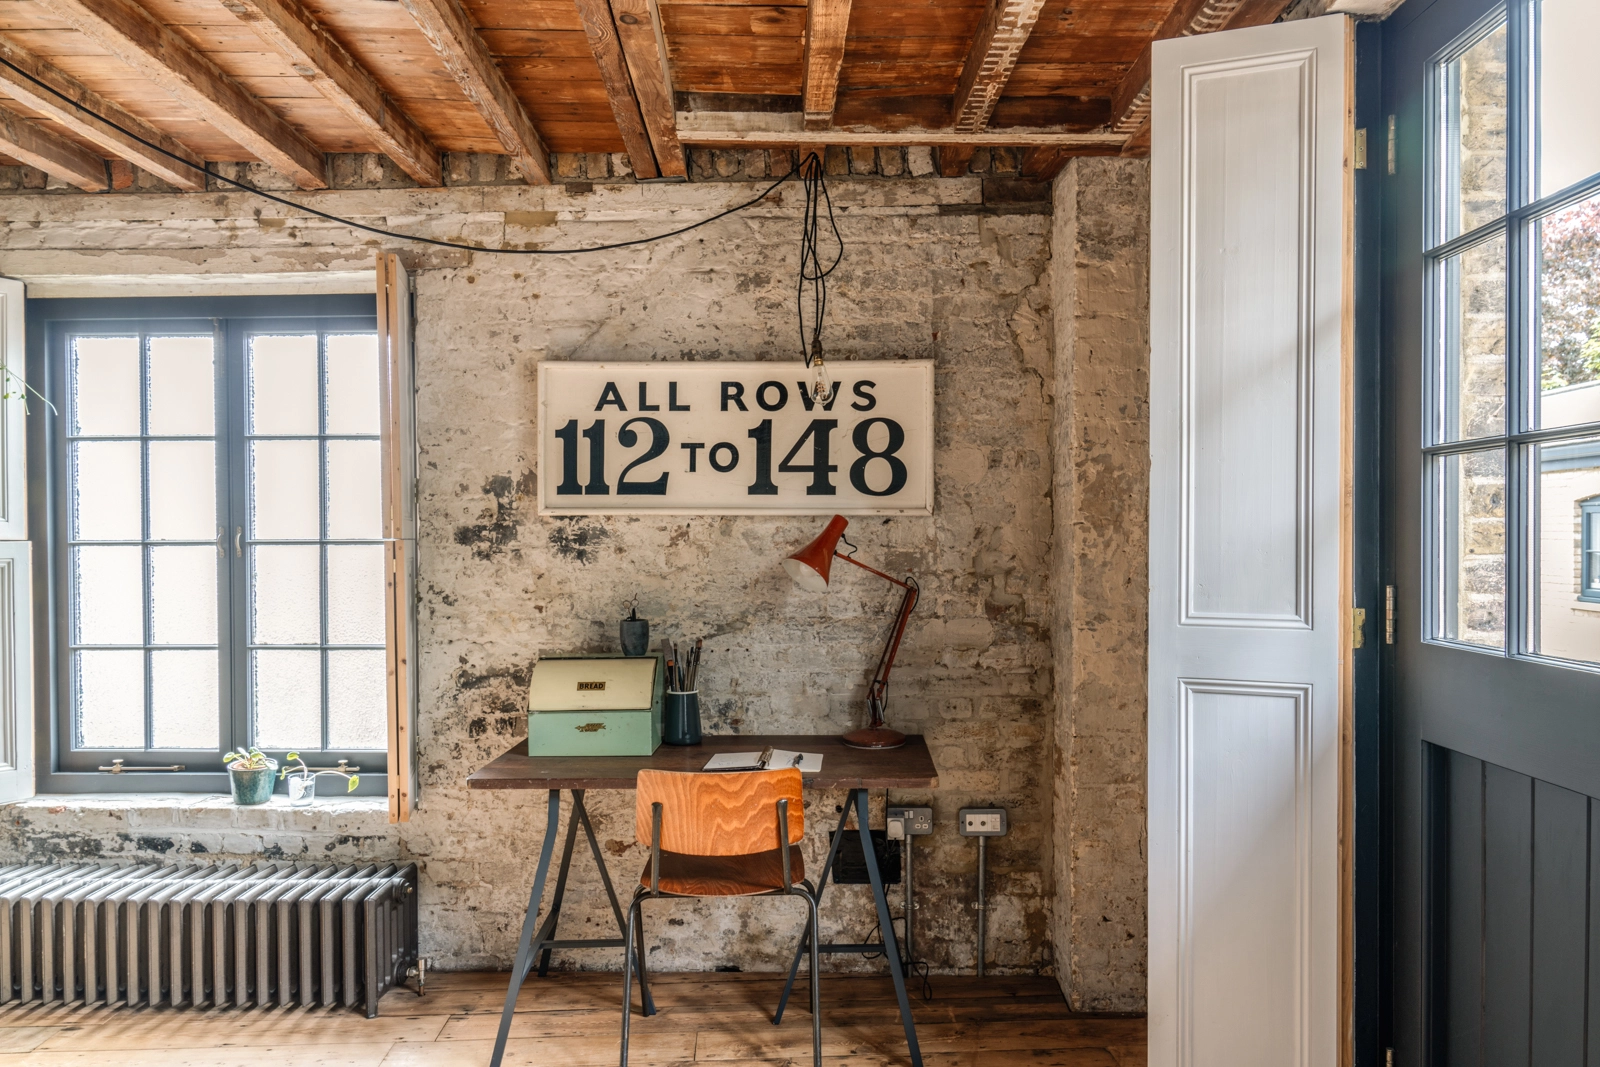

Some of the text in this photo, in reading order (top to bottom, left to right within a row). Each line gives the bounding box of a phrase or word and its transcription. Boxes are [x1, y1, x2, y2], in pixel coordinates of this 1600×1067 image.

[593, 379, 877, 412] ALL ROWS
[554, 416, 908, 497] 112 TO 148
